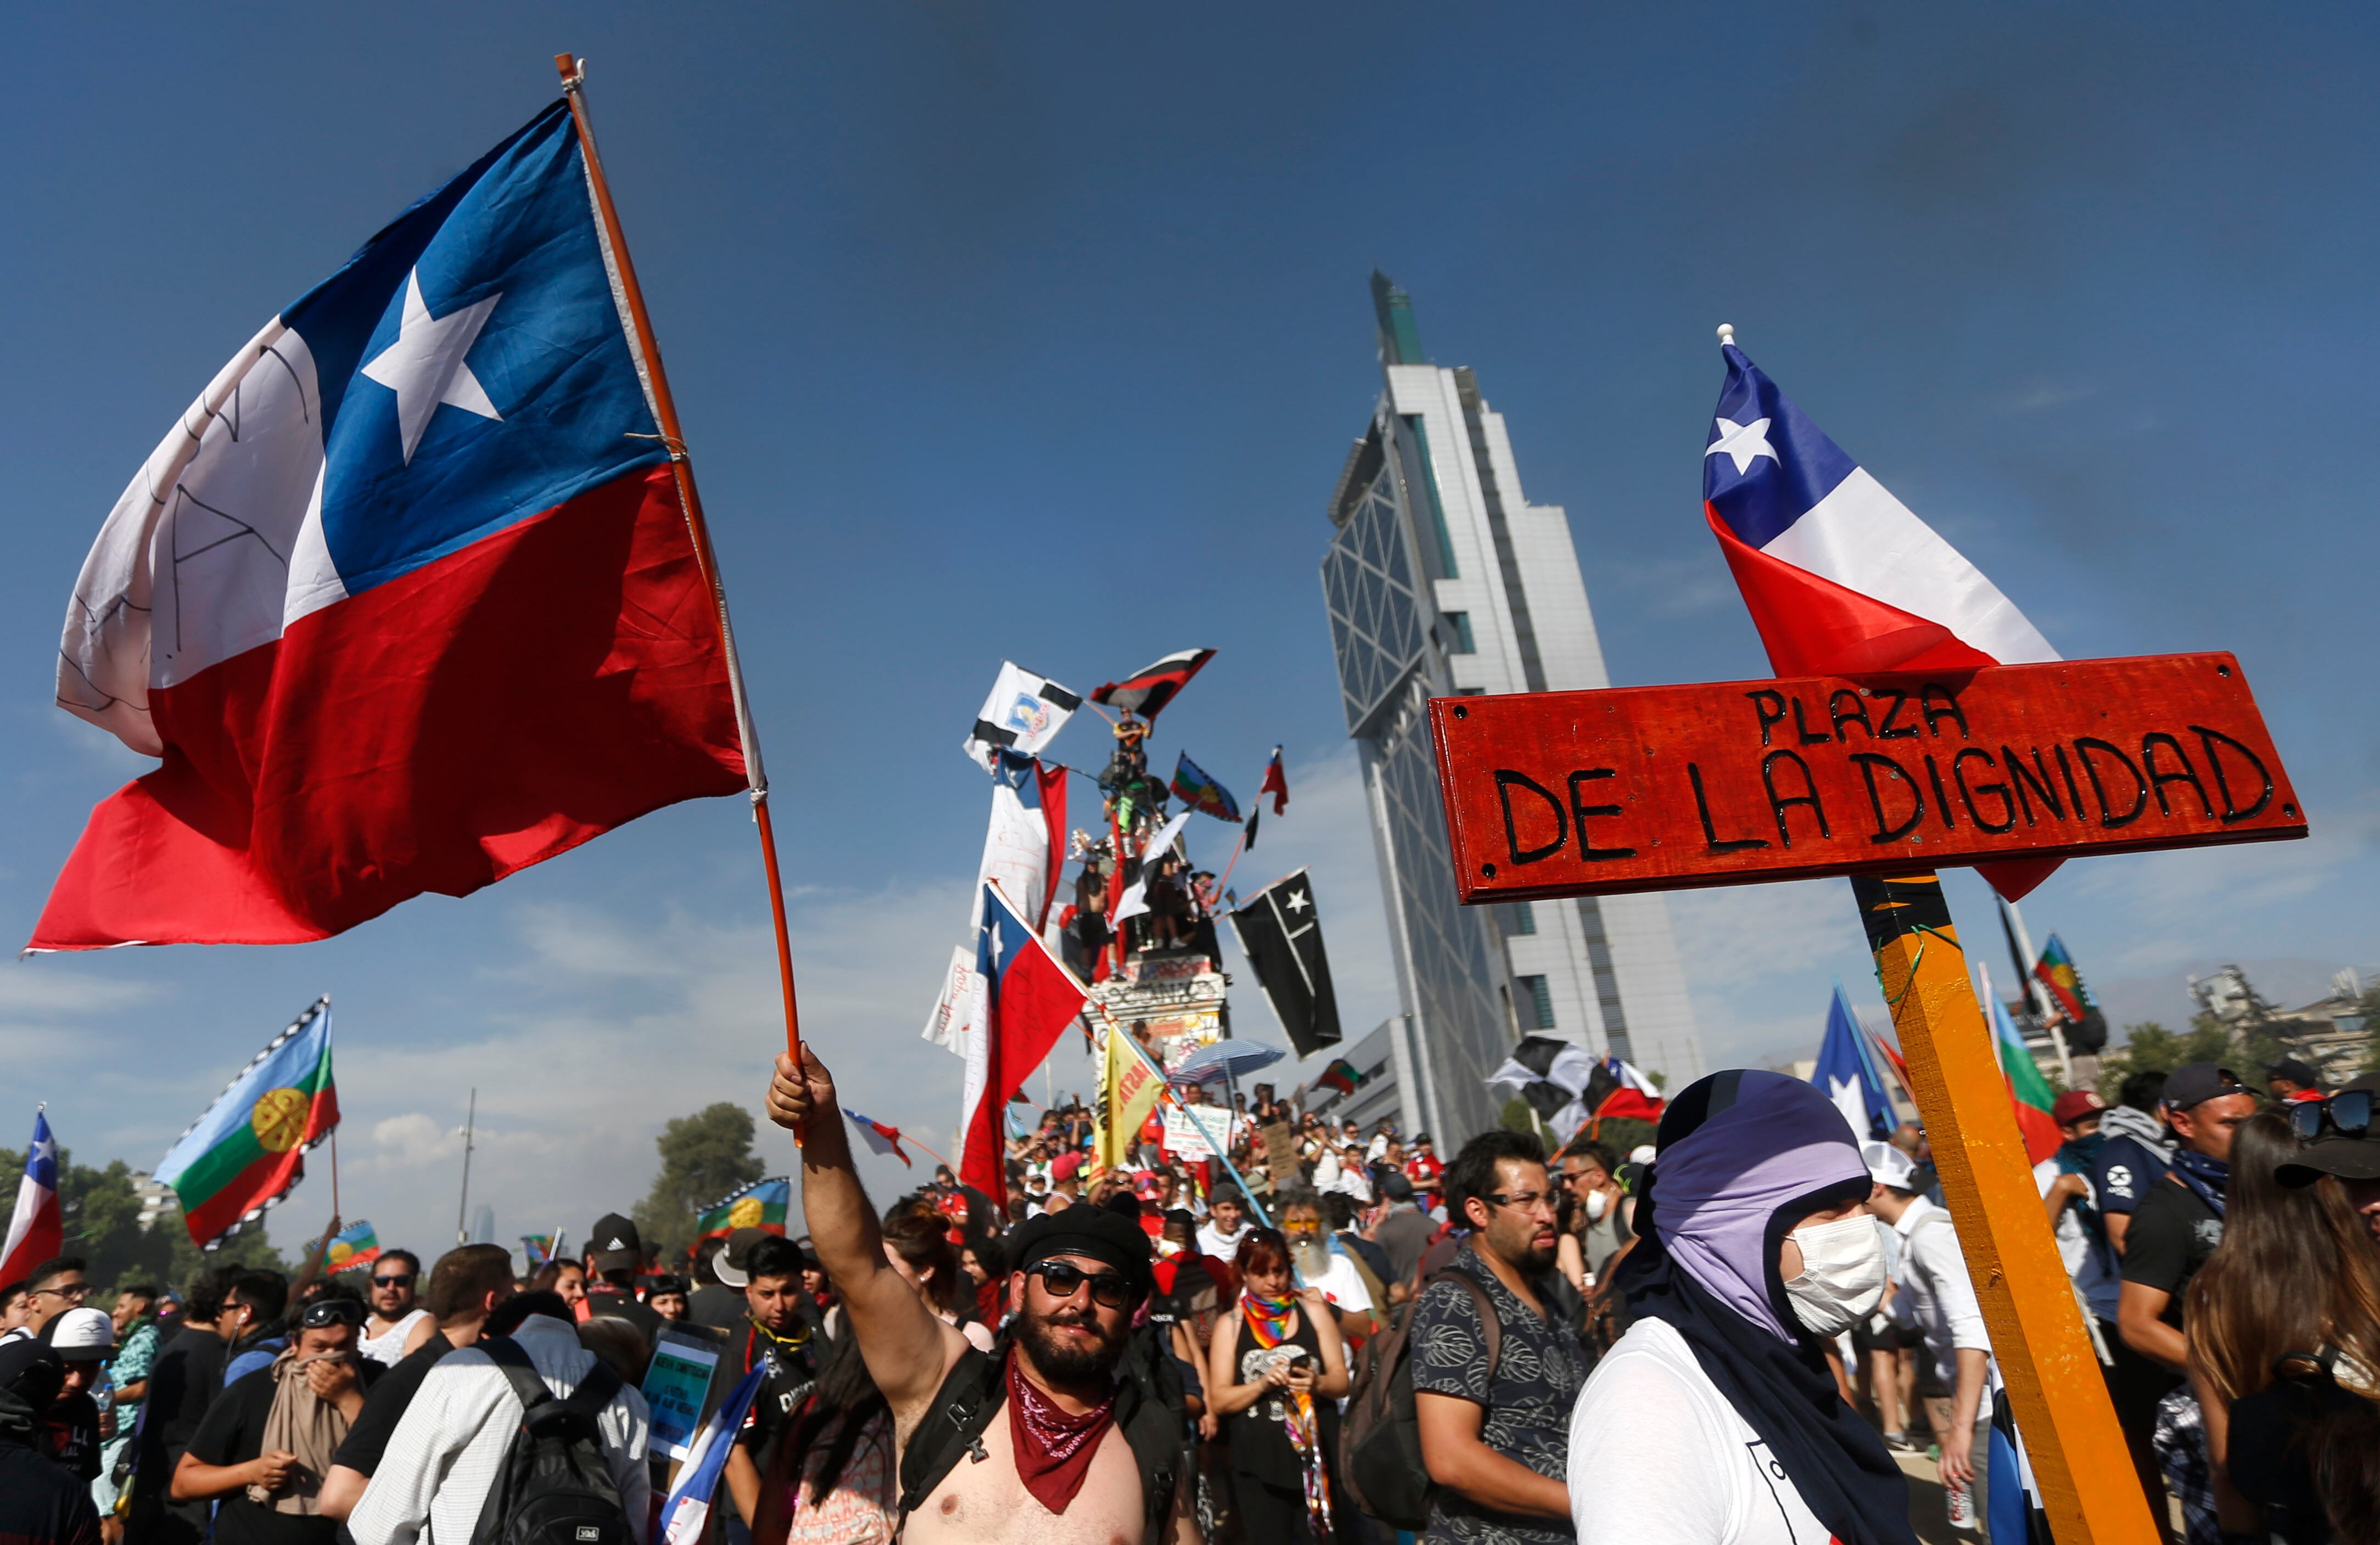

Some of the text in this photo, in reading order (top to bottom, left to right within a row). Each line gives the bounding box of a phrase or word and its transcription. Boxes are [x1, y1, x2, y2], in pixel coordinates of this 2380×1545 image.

[1745, 683, 1969, 746] PLAZA
[1493, 725, 2274, 866] DE LA DIGNIDAD
